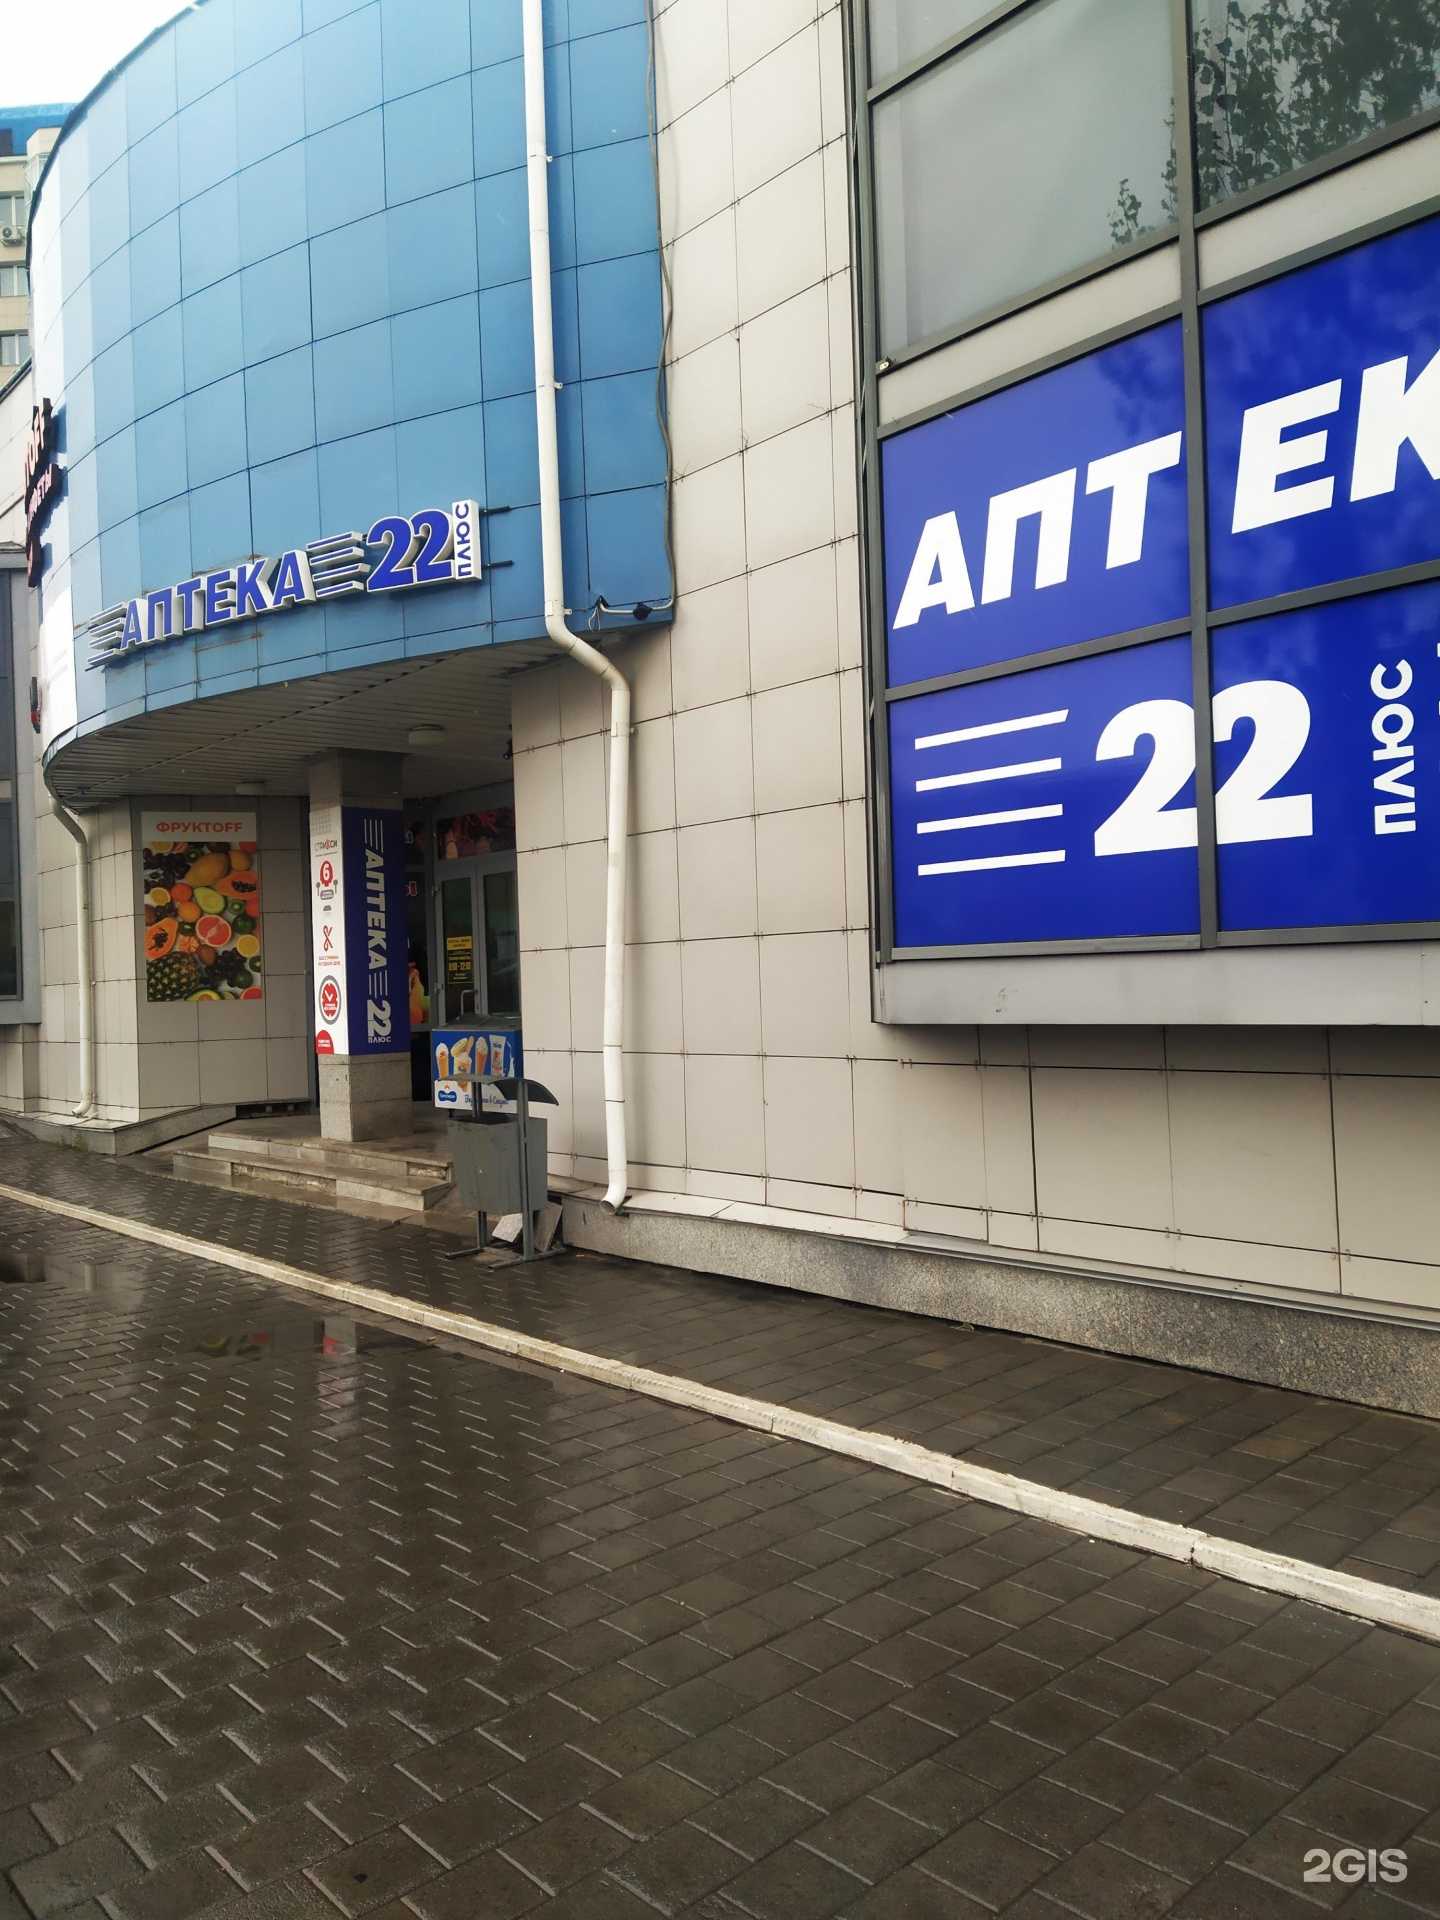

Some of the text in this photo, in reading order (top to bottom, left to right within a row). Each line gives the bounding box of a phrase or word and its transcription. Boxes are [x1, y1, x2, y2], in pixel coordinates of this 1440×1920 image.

[119, 508, 454, 651] АПТЕКА 22
[455, 502, 472, 577] ПЛЮС
[1094, 679, 1314, 857] 22
[1370, 658, 1417, 836] ПЛЮС
[364, 847, 392, 1037] АПТЕКА 22
